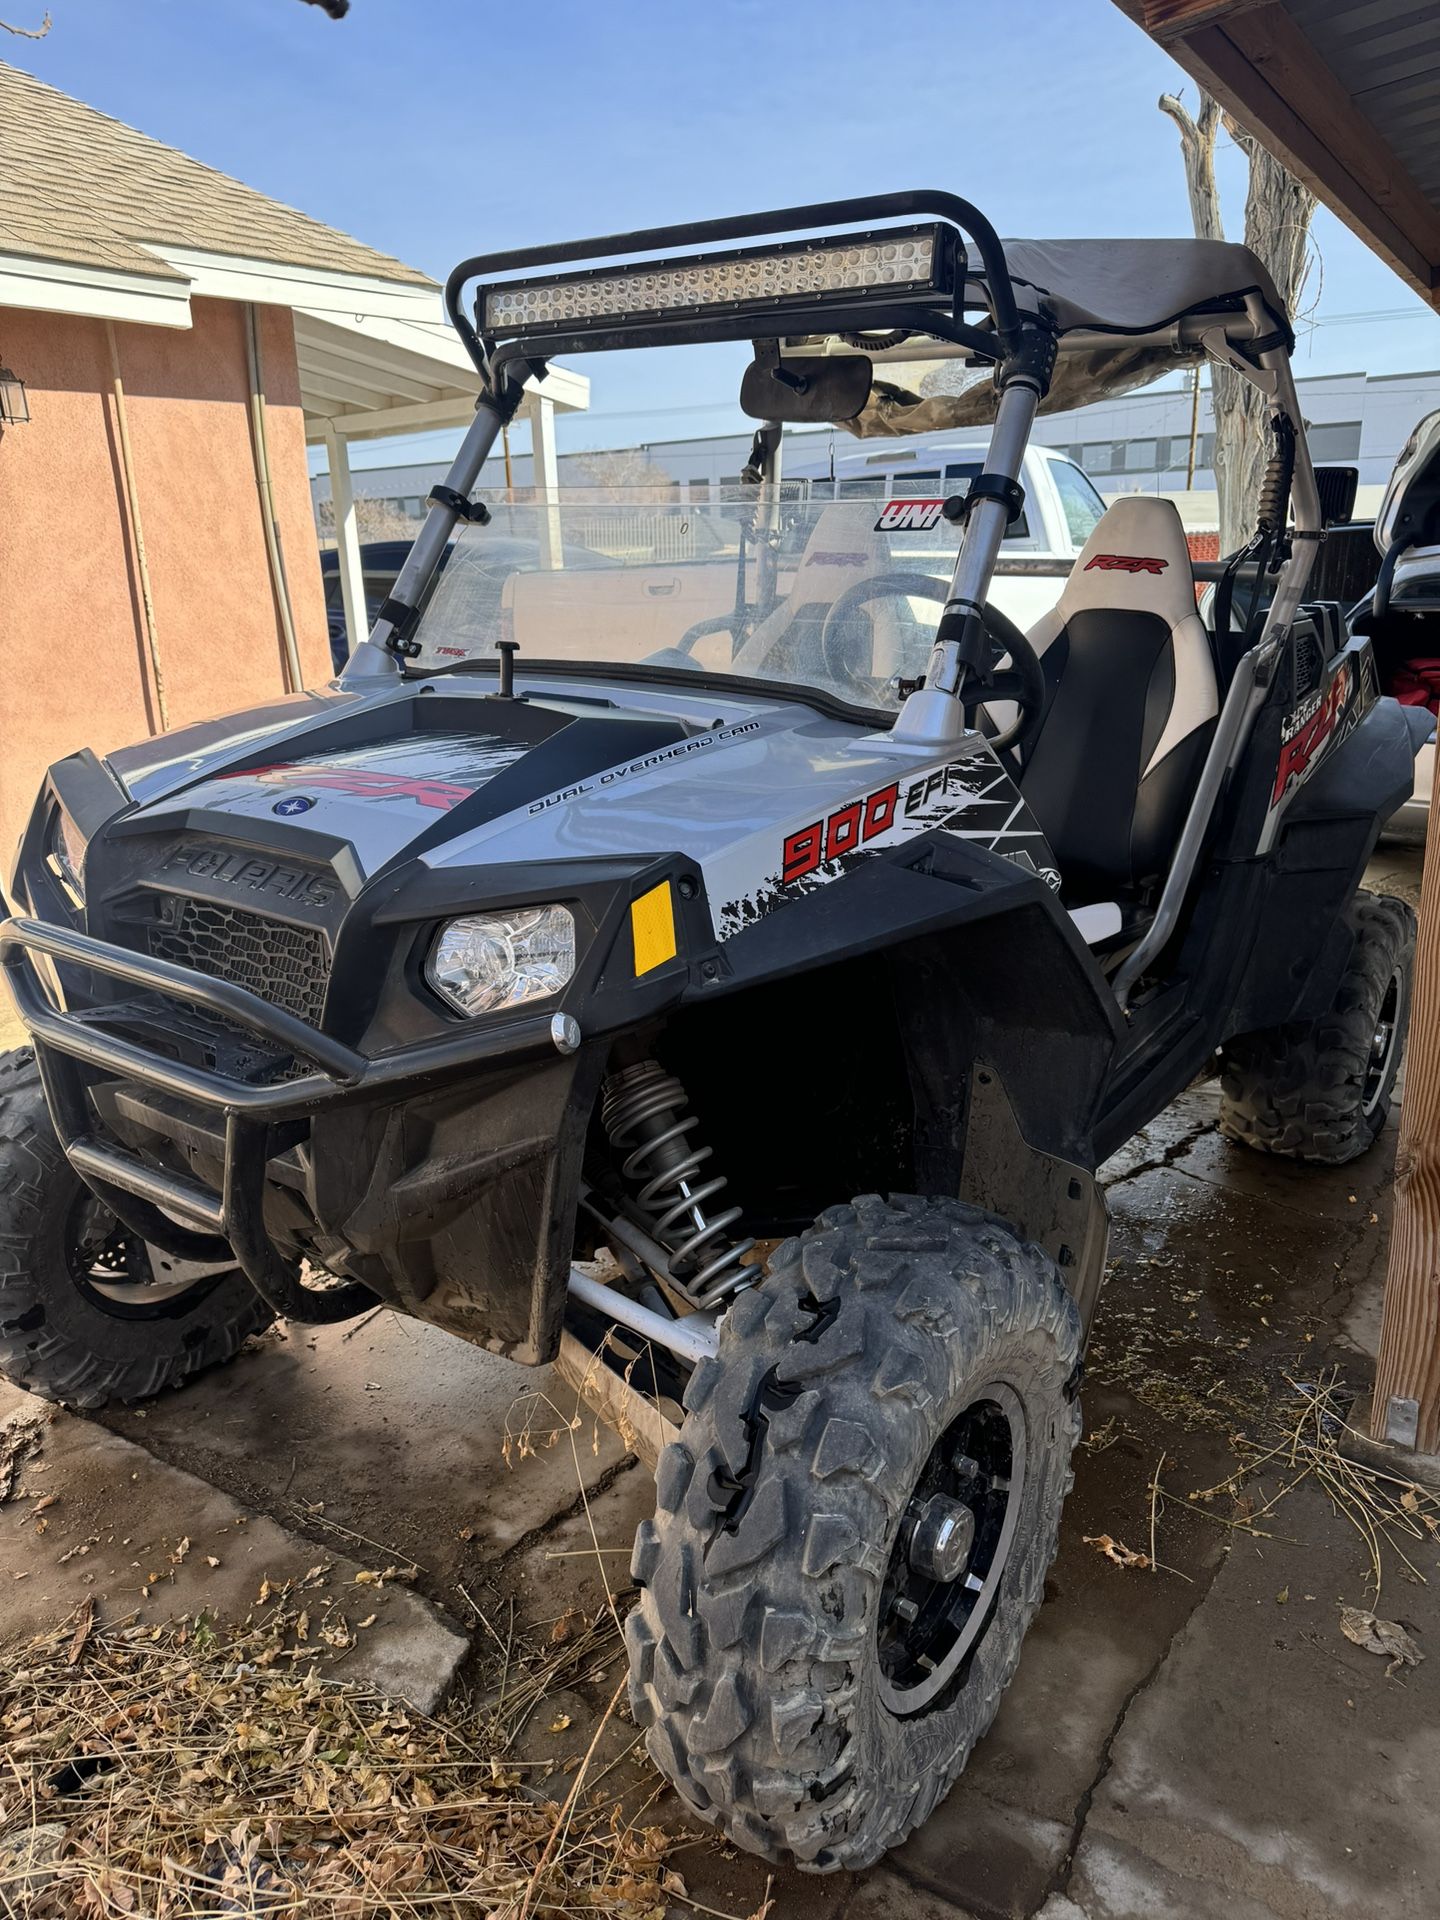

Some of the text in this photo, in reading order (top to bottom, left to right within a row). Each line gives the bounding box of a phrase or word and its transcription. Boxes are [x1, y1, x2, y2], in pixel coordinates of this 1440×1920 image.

[1084, 555, 1169, 575] RZR
[528, 722, 760, 816] DUAL OVERHEAD CAM
[783, 767, 949, 885] 900 EFI
[162, 845, 340, 907] POLARIS
